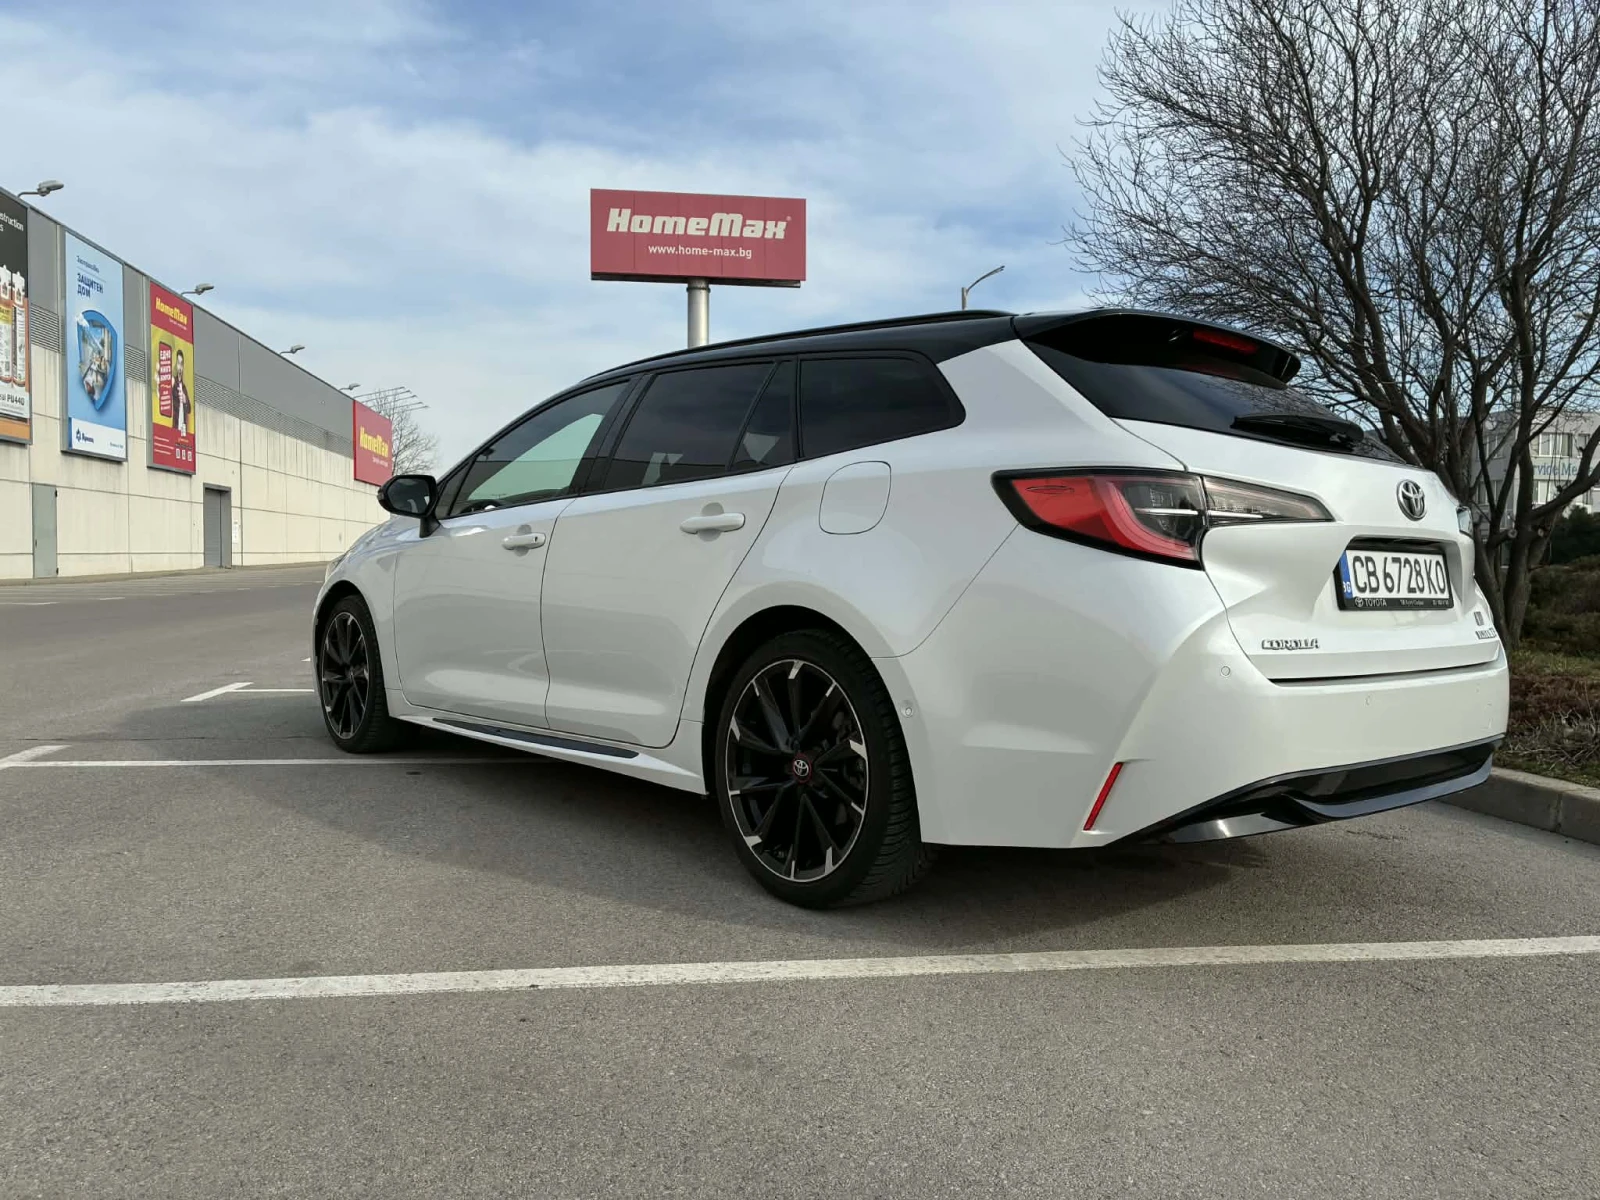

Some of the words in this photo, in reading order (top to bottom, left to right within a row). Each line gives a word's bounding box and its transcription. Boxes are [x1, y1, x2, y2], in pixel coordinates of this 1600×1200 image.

[606, 207, 788, 240] HomeMax
[648, 244, 752, 260] www.home-max.bg
[77, 284, 91, 299] ДОМ
[1352, 555, 1380, 594] CB
[1383, 556, 1425, 594] 6728
[1365, 599, 1387, 607] TOYOTA
